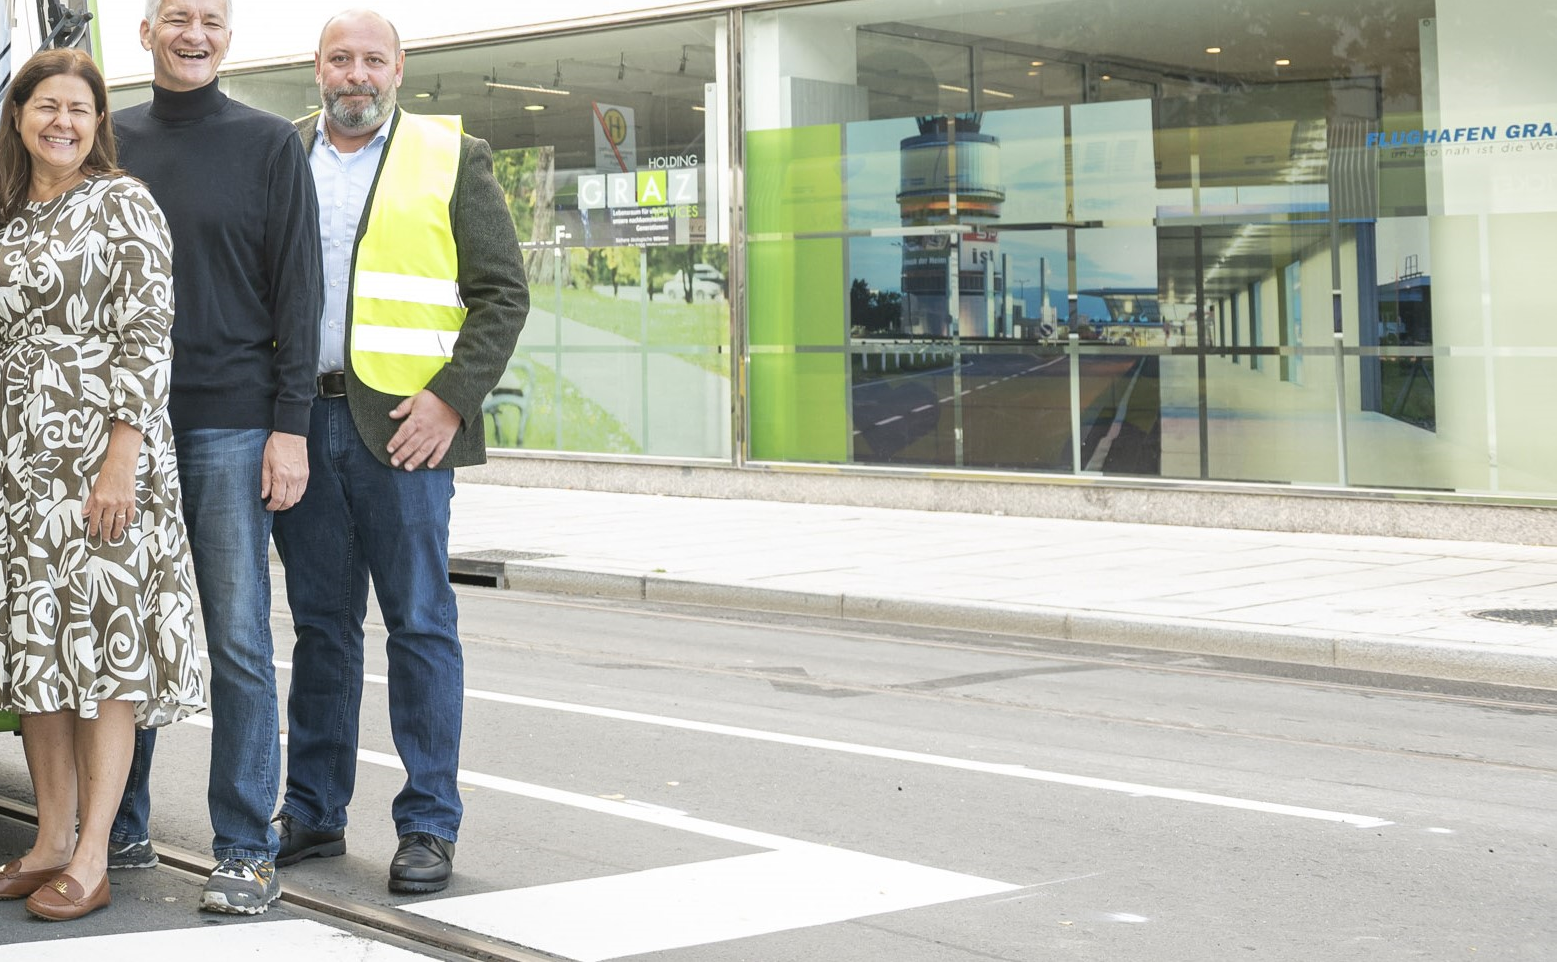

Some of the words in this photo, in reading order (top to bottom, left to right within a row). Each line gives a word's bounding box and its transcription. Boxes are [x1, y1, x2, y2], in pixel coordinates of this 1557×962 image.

[1365, 126, 1496, 149] FLUGHAFEN
[1505, 122, 1557, 139] GRA
[1445, 145, 1470, 156] nah
[1477, 145, 1494, 155] ist
[1501, 142, 1523, 153] die
[648, 154, 698, 169] HOLDING
[583, 173, 693, 206] GRAZ
[651, 205, 699, 219] SERVICES
